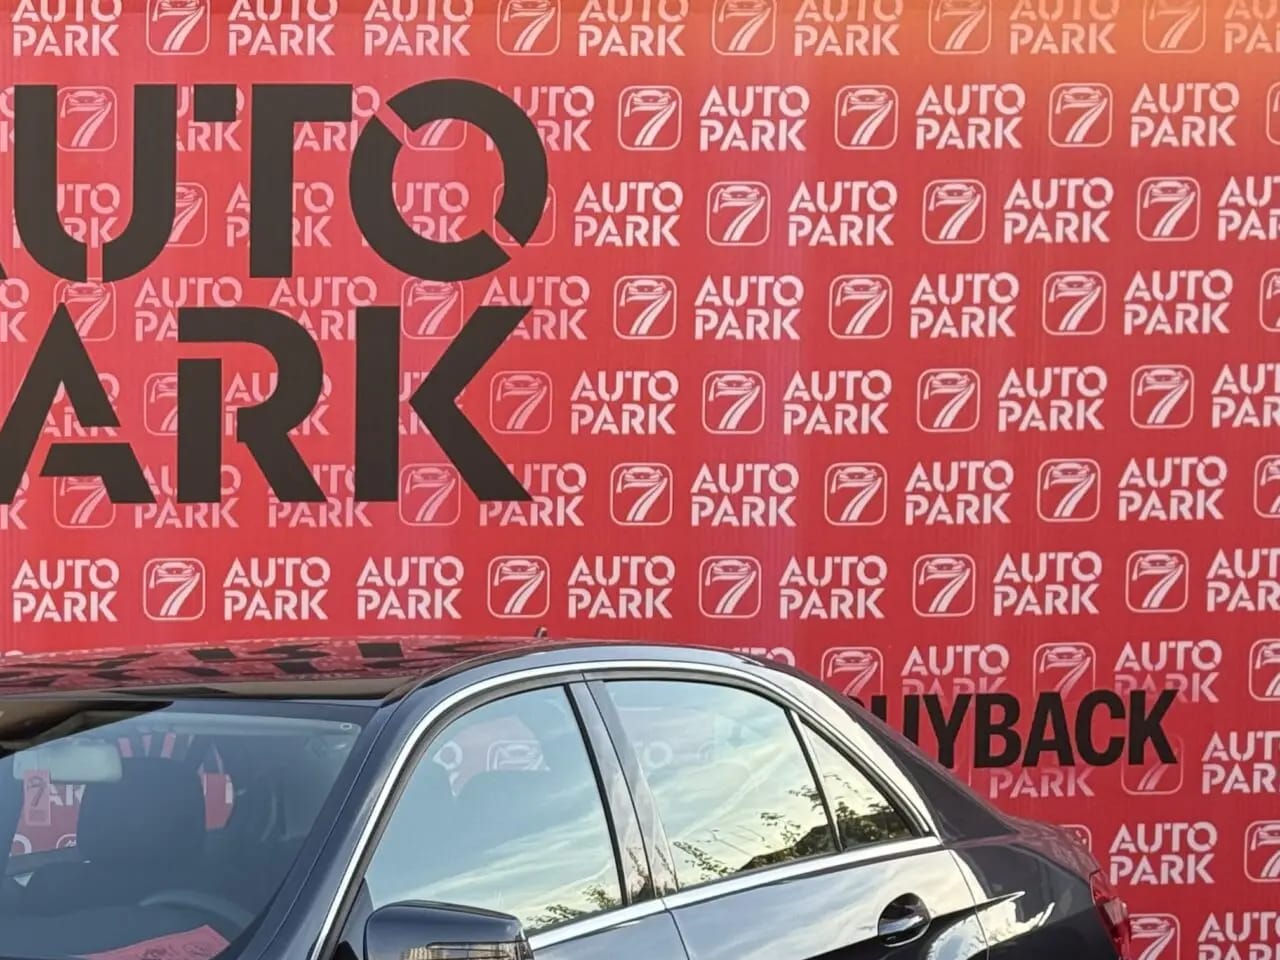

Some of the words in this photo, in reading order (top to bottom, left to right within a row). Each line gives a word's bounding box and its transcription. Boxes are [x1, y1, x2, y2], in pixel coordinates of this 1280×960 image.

[12, 0, 122, 22] AUTO
[228, 0, 337, 22] AUTO
[364, 0, 473, 22] AUTO
[14, 24, 119, 56] PARK
[229, 23, 334, 56] PARK
[365, 24, 470, 56] PARK
[579, 25, 684, 56] PARK
[795, 25, 899, 56] PARK
[1011, 24, 1115, 54] PARK
[700, 86, 810, 117] AUTO
[916, 84, 1025, 115] AUTO
[1131, 82, 1239, 113] AUTO
[700, 119, 806, 151] PARK
[916, 117, 1022, 150] PARK
[1131, 115, 1236, 147] PARK
[574, 181, 683, 213] AUTO
[788, 180, 897, 213] AUTO
[1004, 177, 1114, 210] AUTO
[575, 215, 680, 247] PARK
[788, 214, 894, 246] PARK
[1004, 211, 1110, 244] PARK
[134, 276, 243, 308] AUTO
[269, 276, 377, 308] AUTO
[479, 276, 589, 307] AUTO
[695, 275, 804, 307] AUTO
[910, 272, 1019, 305] AUTO
[1124, 269, 1233, 301] AUTO
[695, 308, 800, 340] PARK
[910, 305, 1016, 338] PARK
[1124, 302, 1229, 335] PARK
[571, 370, 678, 402] AUTO
[783, 370, 892, 401] AUTO
[998, 366, 1107, 398] AUTO
[571, 403, 675, 434] PARK
[784, 403, 888, 435] PARK
[998, 399, 1104, 432] PARK
[691, 463, 799, 494] AUTO
[905, 460, 1014, 492] AUTO
[1118, 456, 1227, 488] AUTO
[134, 499, 240, 529] PARK
[691, 496, 796, 527] PARK
[905, 493, 1010, 525] PARK
[1119, 489, 1224, 521] PARK
[12, 558, 119, 589] AUTO
[223, 557, 330, 587] AUTO
[356, 556, 464, 586] AUTO
[568, 556, 675, 586] AUTO
[779, 555, 887, 586] AUTO
[993, 551, 1102, 584] AUTO
[13, 591, 117, 623] PARK
[224, 589, 328, 620] PARK
[358, 588, 461, 619] PARK
[568, 588, 672, 618] PARK
[780, 588, 884, 619] PARK
[994, 583, 1099, 616] PARK
[901, 644, 1009, 676] AUTO
[1114, 640, 1222, 672] AUTO
[989, 767, 1095, 798] PARK
[1109, 822, 1217, 853] AUTO
[1109, 853, 1215, 885] PARK
